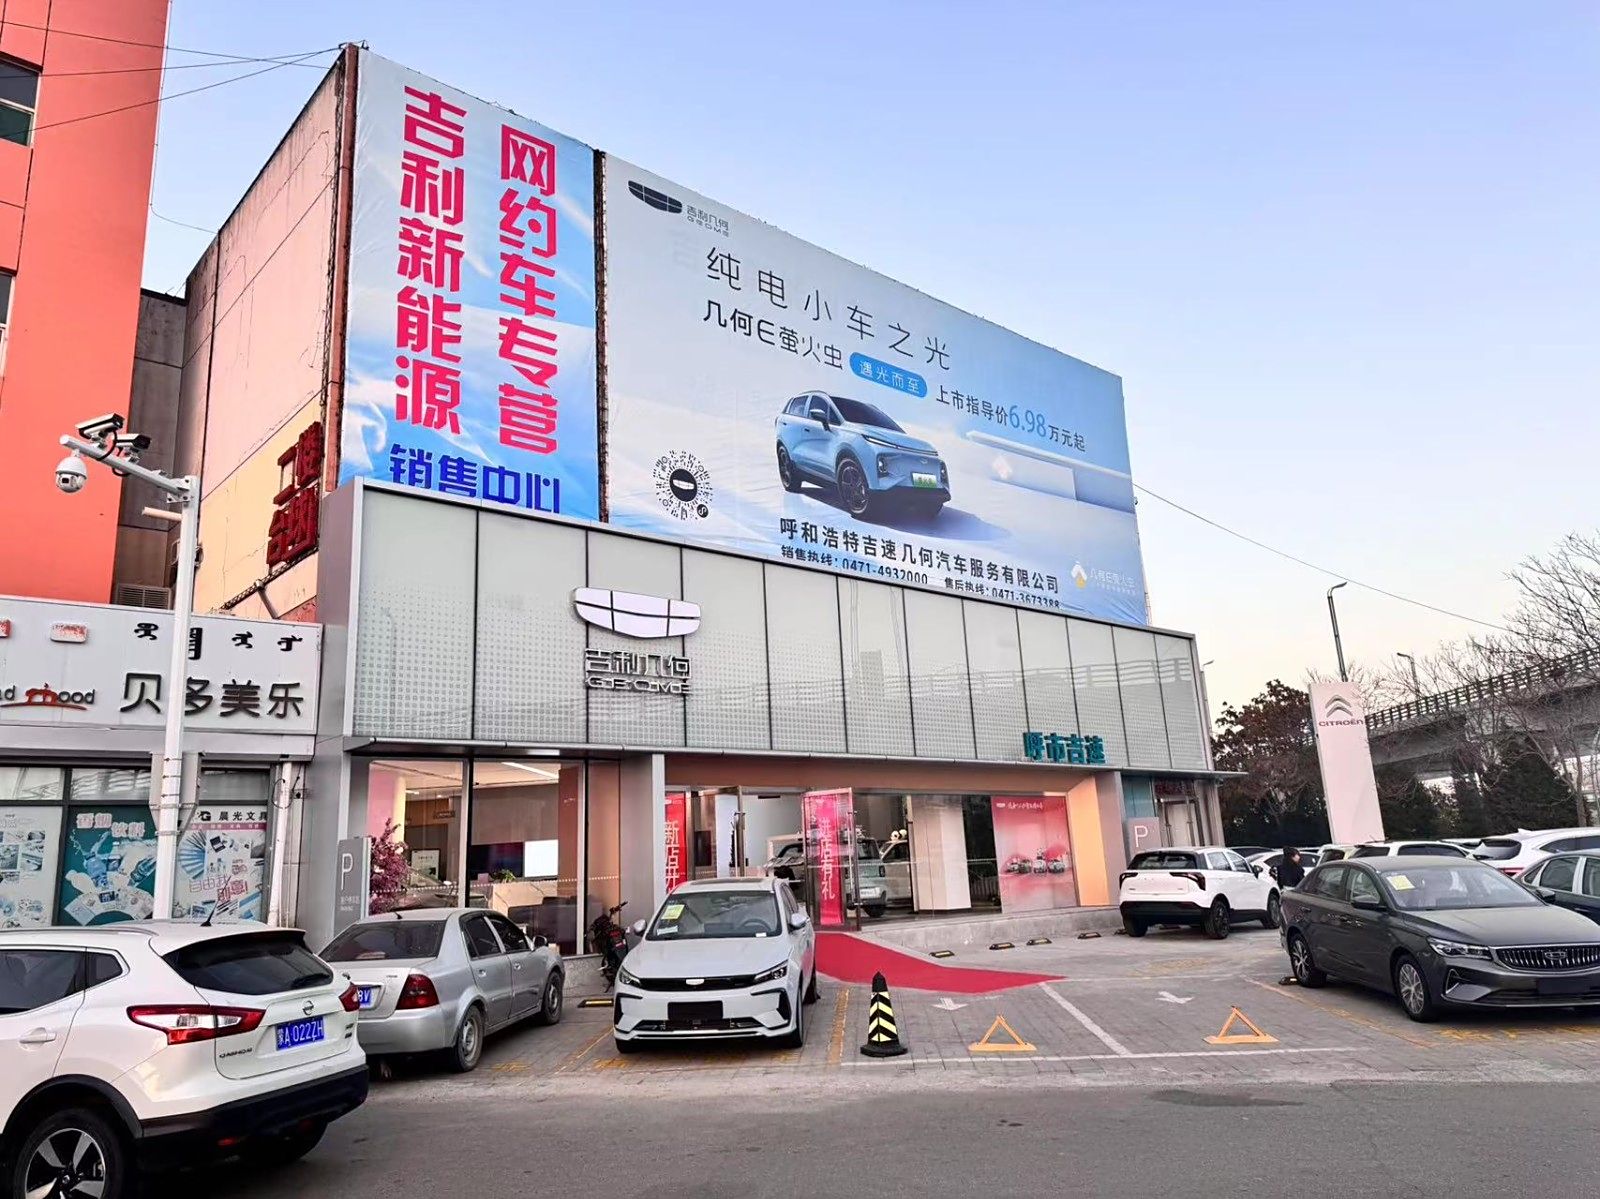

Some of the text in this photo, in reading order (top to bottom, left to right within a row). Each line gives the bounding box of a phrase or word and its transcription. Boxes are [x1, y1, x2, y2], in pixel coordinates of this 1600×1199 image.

[686, 204, 730, 231] 吉利几何
[395, 85, 467, 435] 吉利新能源
[499, 124, 558, 456] 网约车专营
[703, 299, 844, 370] 几何E萤火虫
[706, 247, 951, 371] 纯电小车之光
[859, 359, 1086, 453] 遇光而至 上市指导价6.98万元起
[389, 443, 560, 514] 销售中心
[779, 517, 1059, 594] 呼和浩特吉速几何汽车服务有限公司
[120, 672, 304, 719] 贝多美乐
[584, 647, 692, 680] 吉利几何
[341, 853, 354, 890] P
[664, 819, 680, 893] 新店开
[1134, 824, 1150, 848] P
